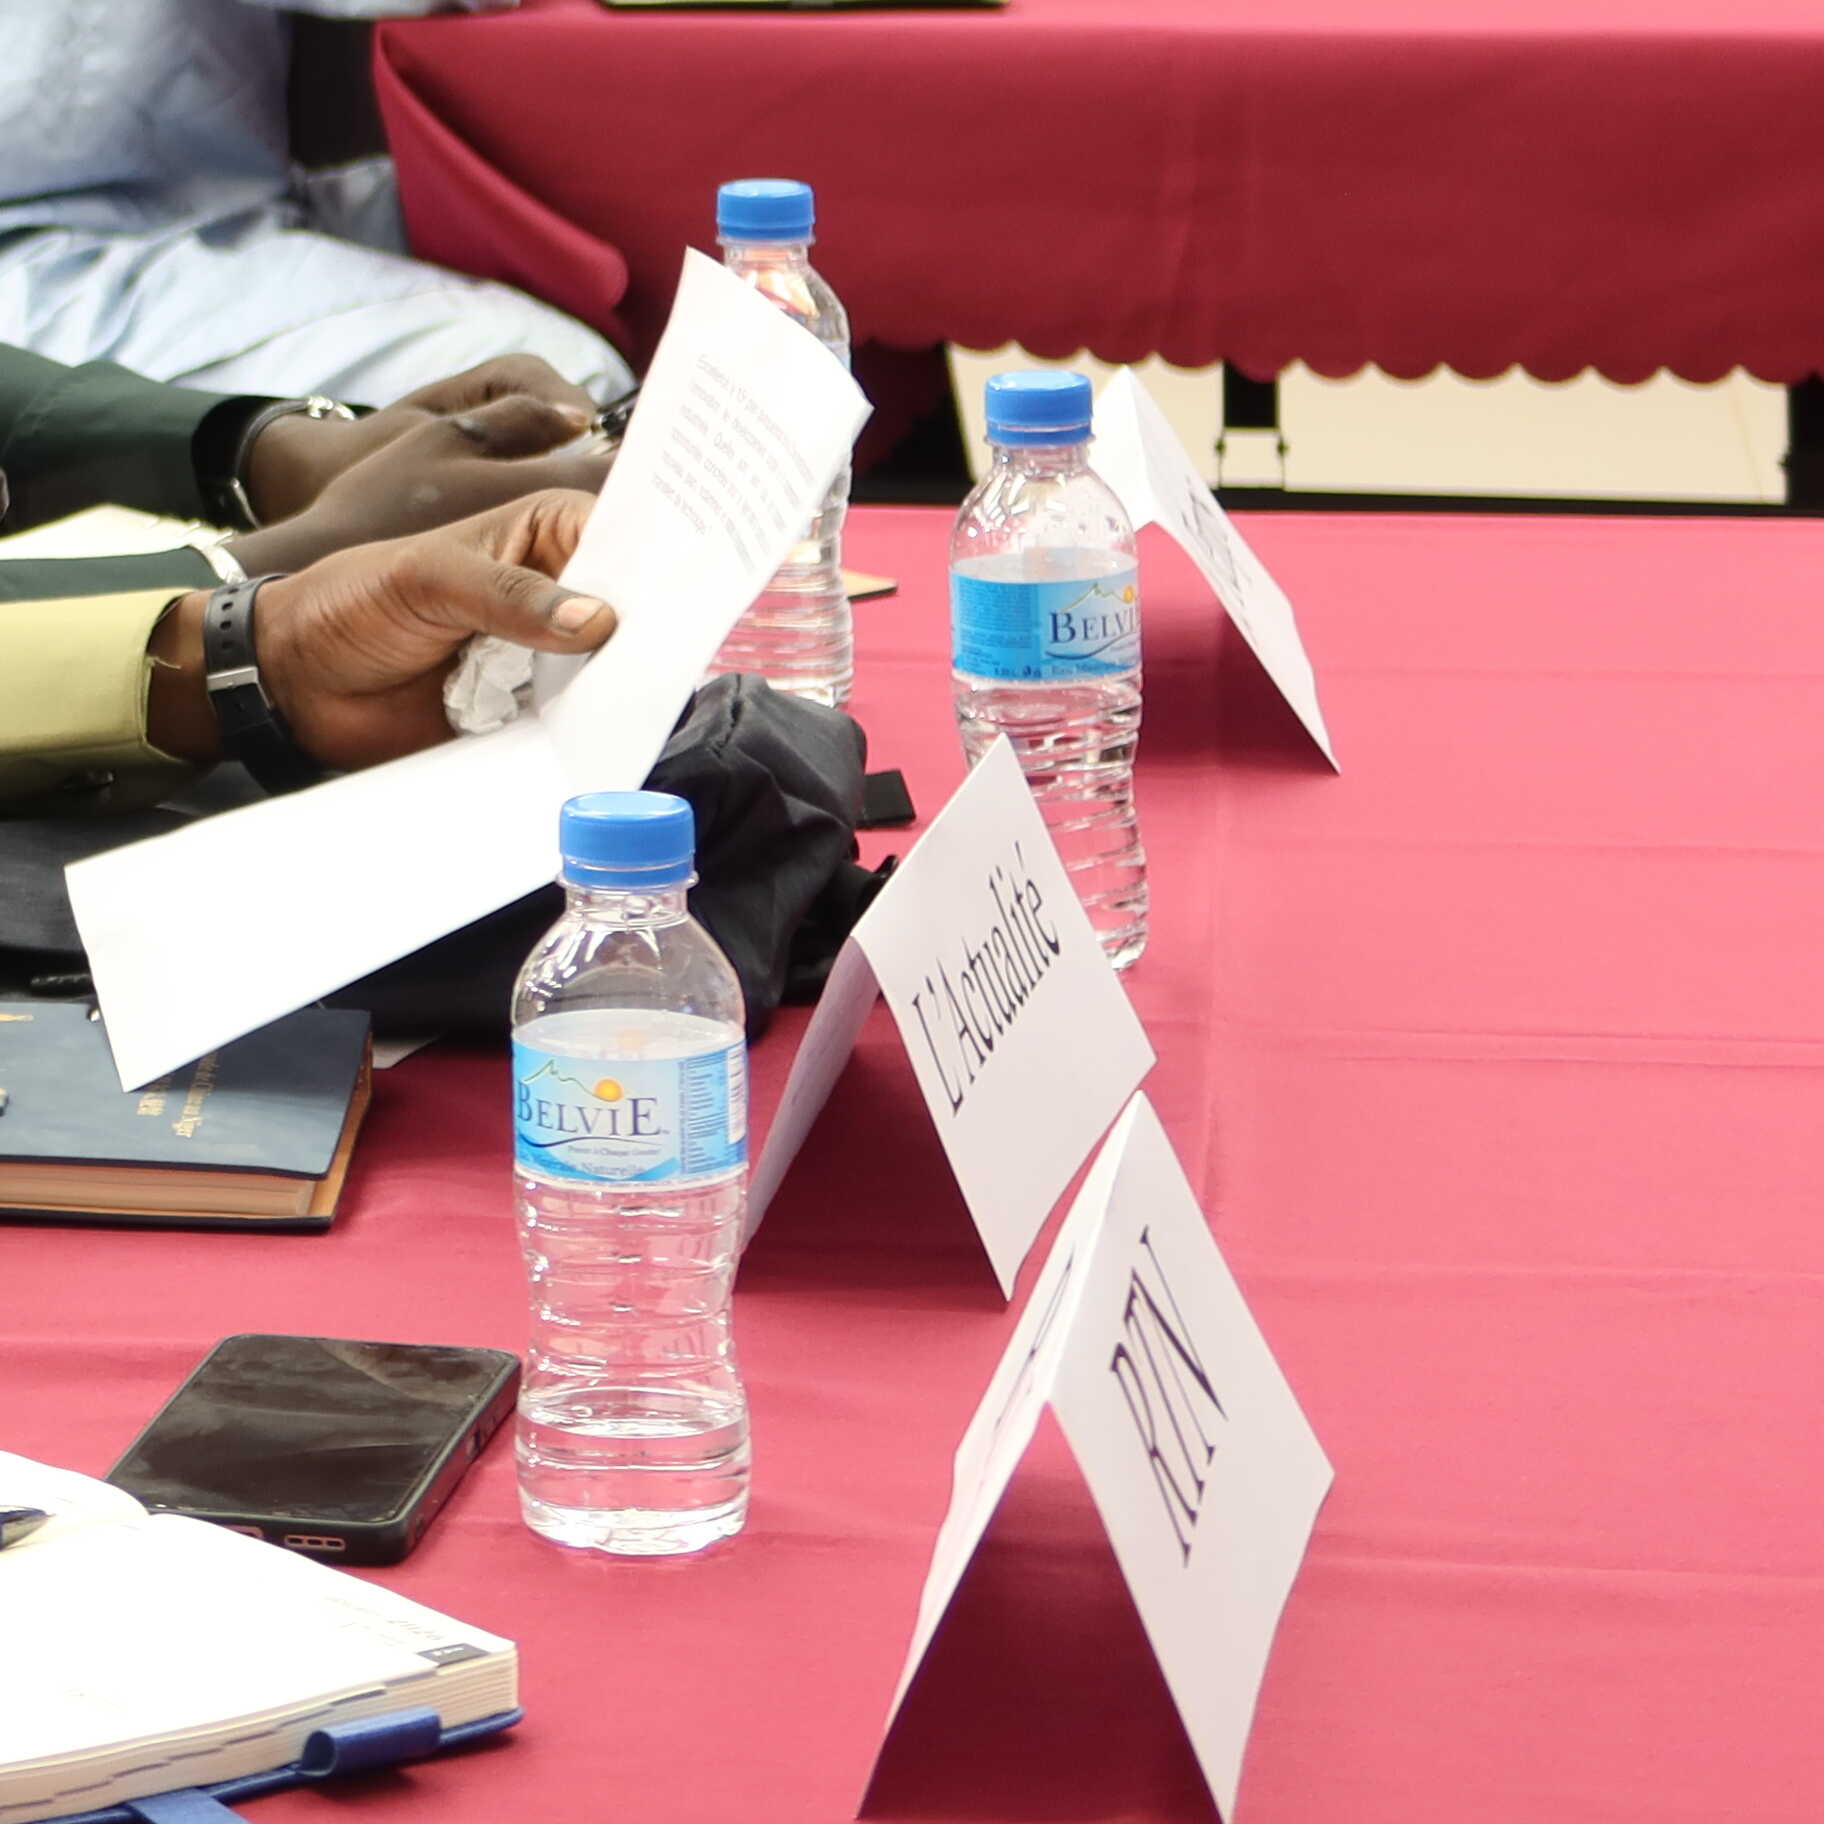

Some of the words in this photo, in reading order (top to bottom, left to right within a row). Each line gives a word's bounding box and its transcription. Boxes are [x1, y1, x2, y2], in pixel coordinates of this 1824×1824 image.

[1049, 607, 1138, 645] BELVI
[911, 840, 1060, 1118] L'Actualité
[517, 1080, 662, 1137] BELVIE
[1109, 1224, 1229, 1568] RTN
